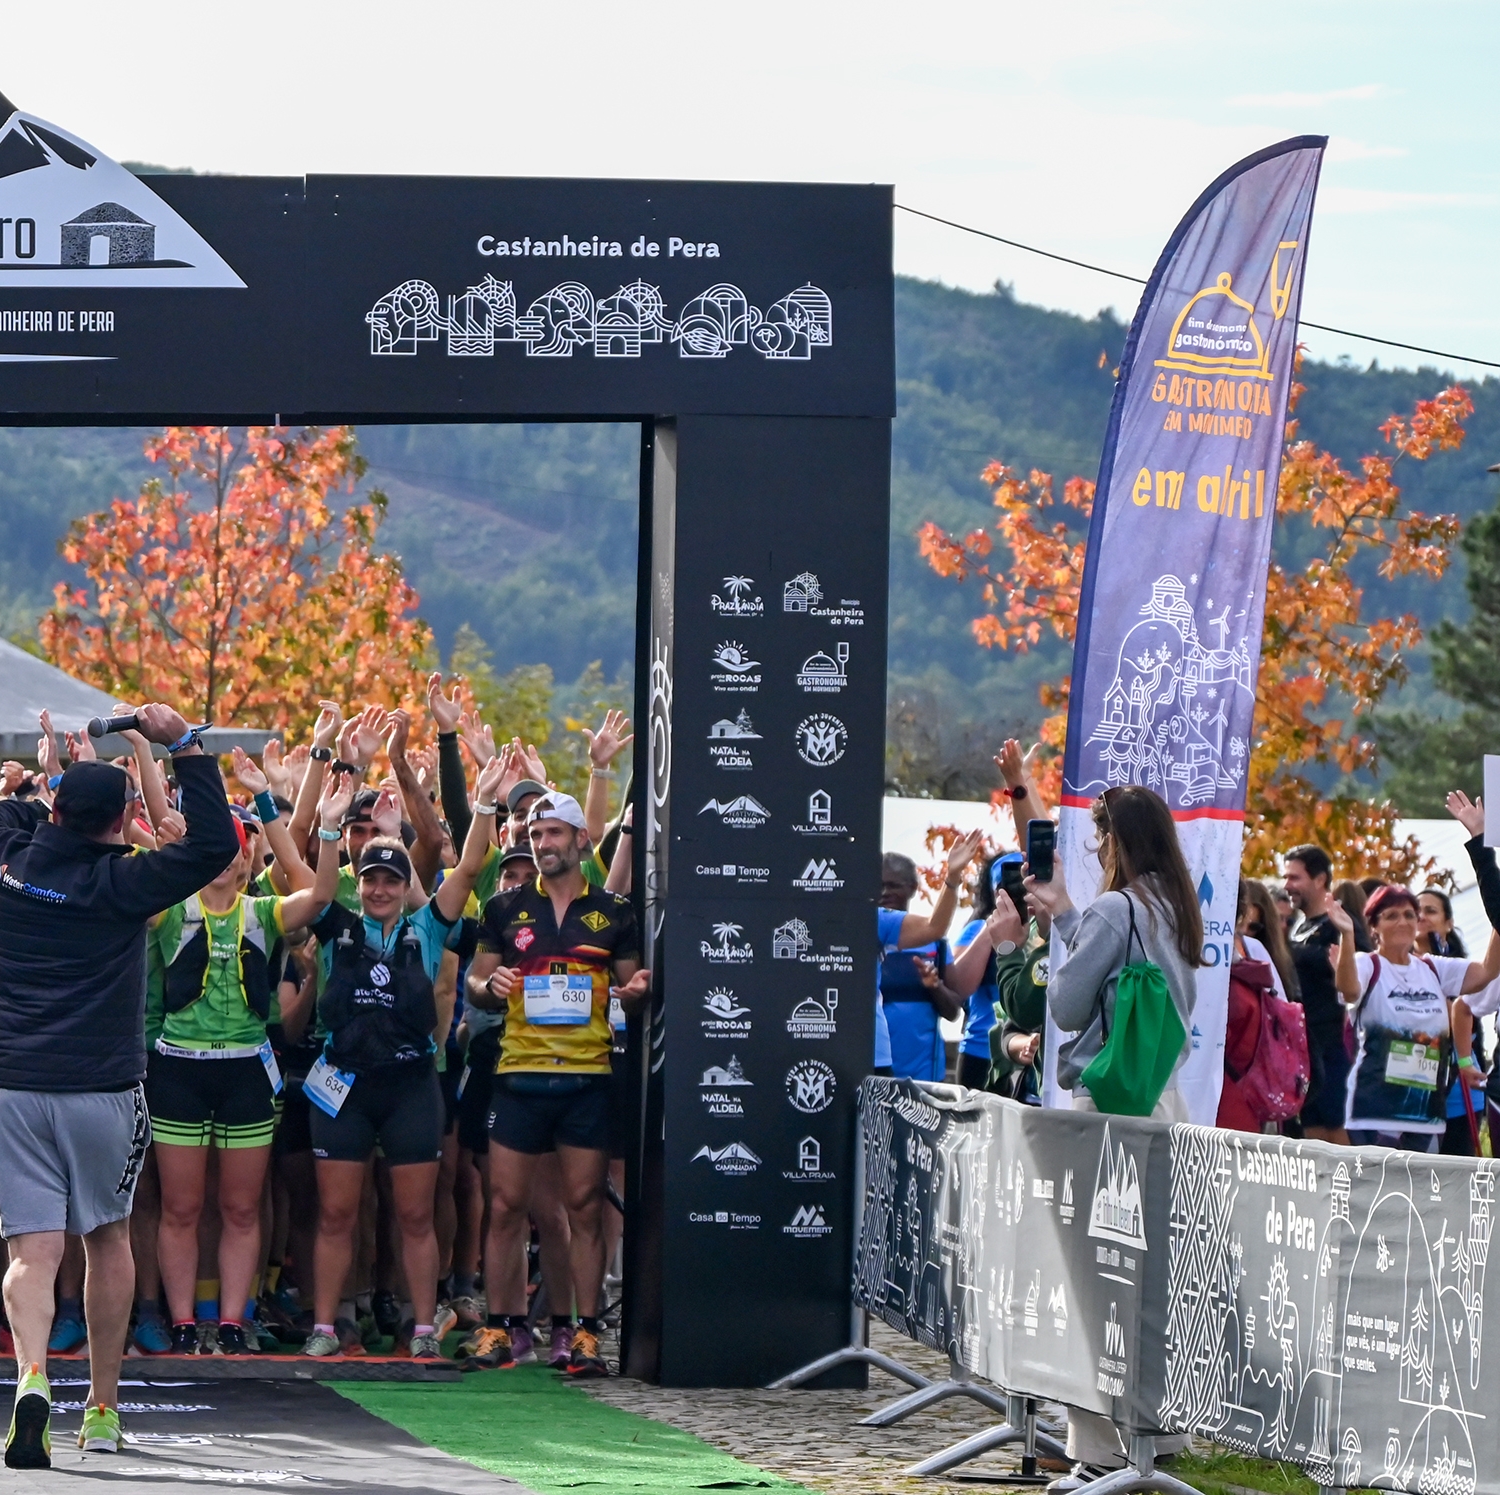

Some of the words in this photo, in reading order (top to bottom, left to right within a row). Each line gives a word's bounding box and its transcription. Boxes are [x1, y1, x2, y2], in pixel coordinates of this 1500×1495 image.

[477, 234, 623, 257] Castanheira
[630, 236, 660, 257] de
[669, 237, 721, 258] Pera
[57, 310, 77, 334] DE
[79, 310, 116, 334] PERA
[1187, 316, 1205, 329] fim
[1152, 371, 1272, 416] GASTRONOIA
[1163, 410, 1182, 433] EM
[1132, 466, 1186, 511] em
[810, 606, 865, 617] Castanheira
[830, 616, 842, 626] de
[844, 616, 865, 626] Pera
[725, 674, 762, 683] ROCAS
[797, 677, 848, 687] GASTRONOMIA
[710, 746, 739, 756] NATAL
[716, 756, 753, 767] ALDEIA
[696, 865, 721, 875] Casa
[738, 865, 770, 877] Tempo
[2, 872, 67, 900] WaterComfort
[793, 879, 845, 888] MOVEMENT
[799, 953, 854, 963] Castanheira
[820, 963, 831, 972] de
[833, 963, 853, 972] Pera
[562, 990, 587, 1003] 630
[715, 1021, 752, 1030] ROCAS
[787, 1023, 837, 1033] GASTRONOMIA
[1417, 1059, 1437, 1072] 1014
[324, 1075, 345, 1095] 634
[702, 1093, 731, 1103] NATAL
[708, 1103, 744, 1114] ALDEIA
[1233, 1136, 1318, 1193] Castanheira
[808, 1172, 837, 1180] PRAIA
[689, 1212, 714, 1222] Casa
[730, 1212, 762, 1224] Tempo
[1265, 1195, 1283, 1246] de
[1286, 1200, 1316, 1253] Pera
[783, 1226, 834, 1234] MOVEMENT
[1347, 1311, 1362, 1327] mais
[1362, 1316, 1374, 1333] que
[1346, 1335, 1358, 1351] que
[1343, 1356, 1356, 1373] que
